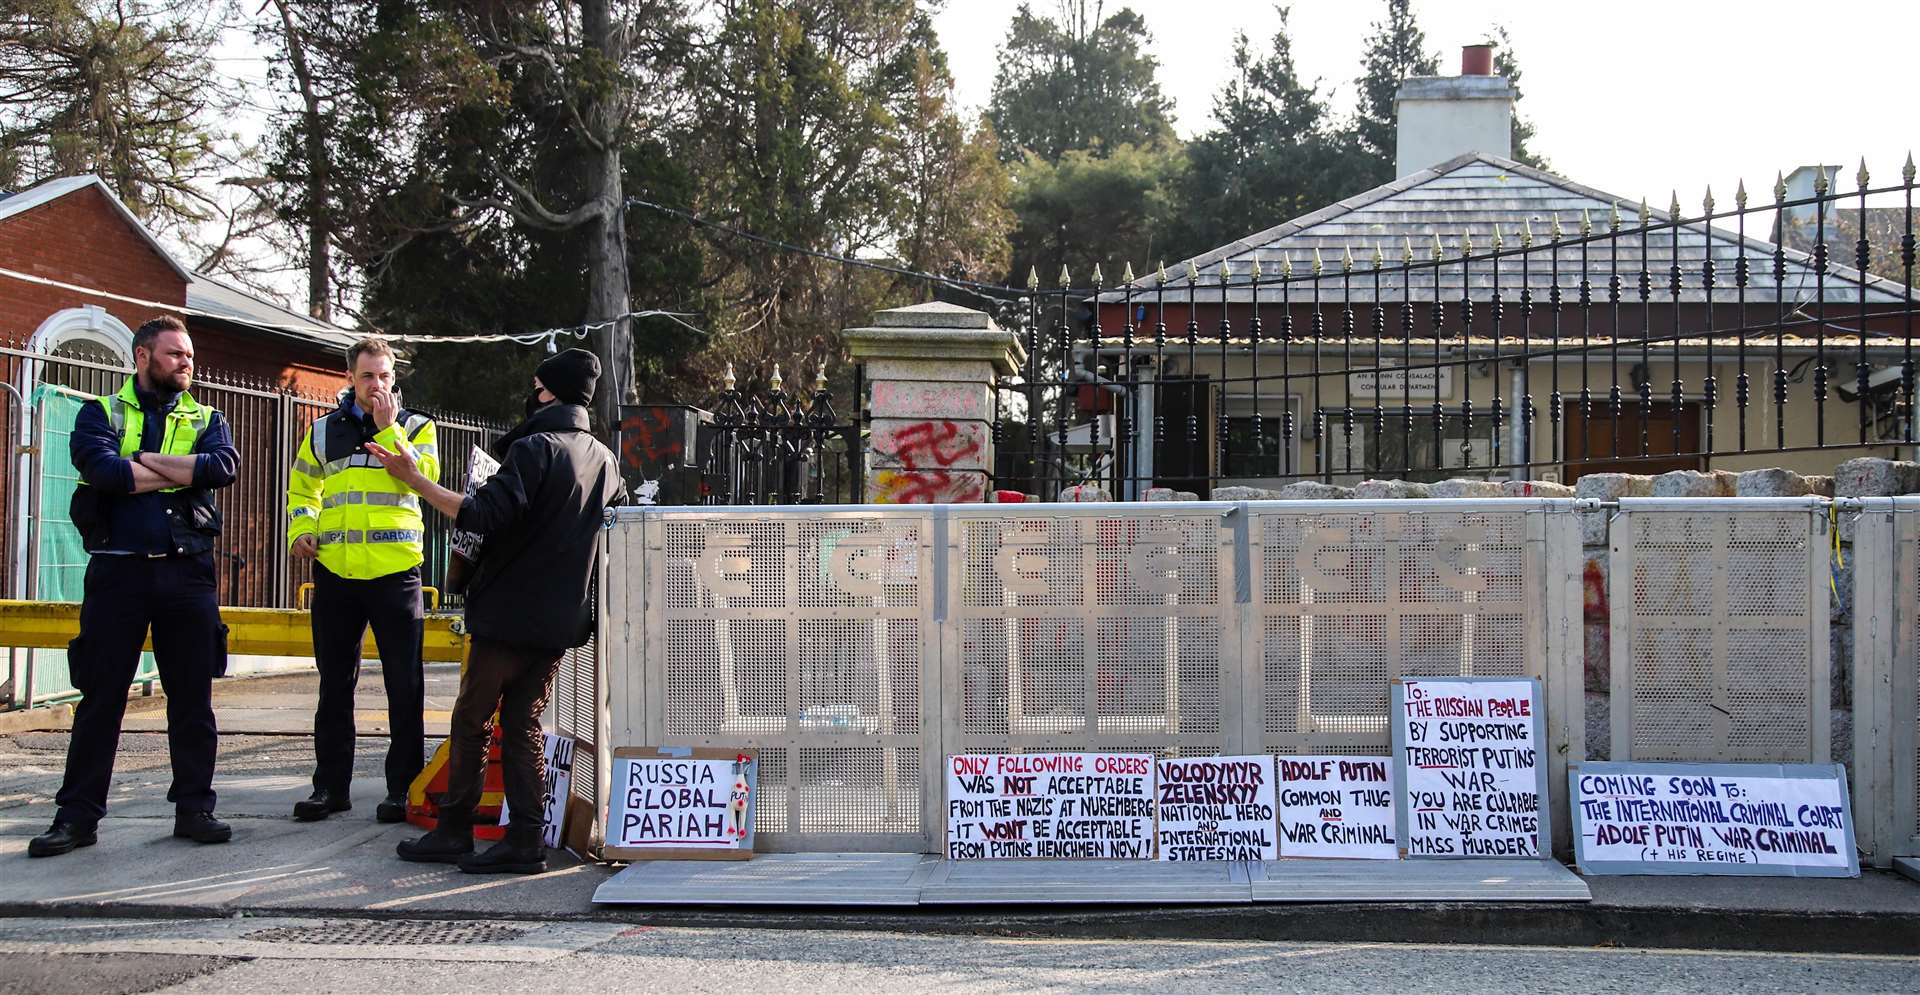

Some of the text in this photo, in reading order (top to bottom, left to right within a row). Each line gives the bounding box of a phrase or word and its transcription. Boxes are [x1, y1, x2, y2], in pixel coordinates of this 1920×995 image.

[373, 531, 411, 541] GARDA
[1405, 696, 1531, 717] THE RUSSIAN PEOPLE
[1409, 721, 1528, 742] BY SUPPORTING
[551, 737, 571, 771] ALL
[1406, 746, 1479, 769] TERRORIST
[629, 761, 714, 786] RUSSIA
[953, 754, 1149, 775] ONLY FOLLOWING ORDERS
[1159, 762, 1264, 784] VOLODYMYR
[1339, 761, 1386, 781] PUTIN
[958, 776, 1143, 795] WAS NOT ACCEPTABLE
[1159, 783, 1258, 804] ZELENSKYY
[1581, 775, 1656, 795] COMING
[1669, 777, 1716, 797] SOON
[627, 788, 726, 810] GLOBAL
[951, 800, 984, 817] FROM
[987, 800, 1011, 817] THE
[1059, 800, 1075, 817] AT
[1081, 799, 1154, 817] NUREMBERG
[1281, 789, 1390, 807] COMMON THUG
[1410, 791, 1538, 814] YOU ARE CULPABLE
[1161, 804, 1272, 821] NATIONAL HERO
[1320, 808, 1342, 817] AND
[1580, 797, 1842, 829] THE INTERNATIONAL CRIMINAL COURT
[622, 811, 723, 841] PARIAH
[1033, 819, 1049, 837] BE
[1056, 819, 1141, 839] ACCEPTABLE
[1198, 821, 1218, 830] AND
[1281, 822, 1395, 844] WAR CRIMINAL
[1418, 813, 1537, 833] IN WAR CRIMES
[1161, 829, 1271, 846] INTERNATIONAL
[1411, 837, 1454, 854] MASS
[1711, 827, 1755, 849] WAR
[1756, 828, 1837, 854] CRIMINAL
[950, 841, 985, 858] FROM
[1037, 841, 1104, 857] HENCHMEN
[1169, 846, 1261, 861] STATESMAN
[1668, 847, 1686, 859] HIS
